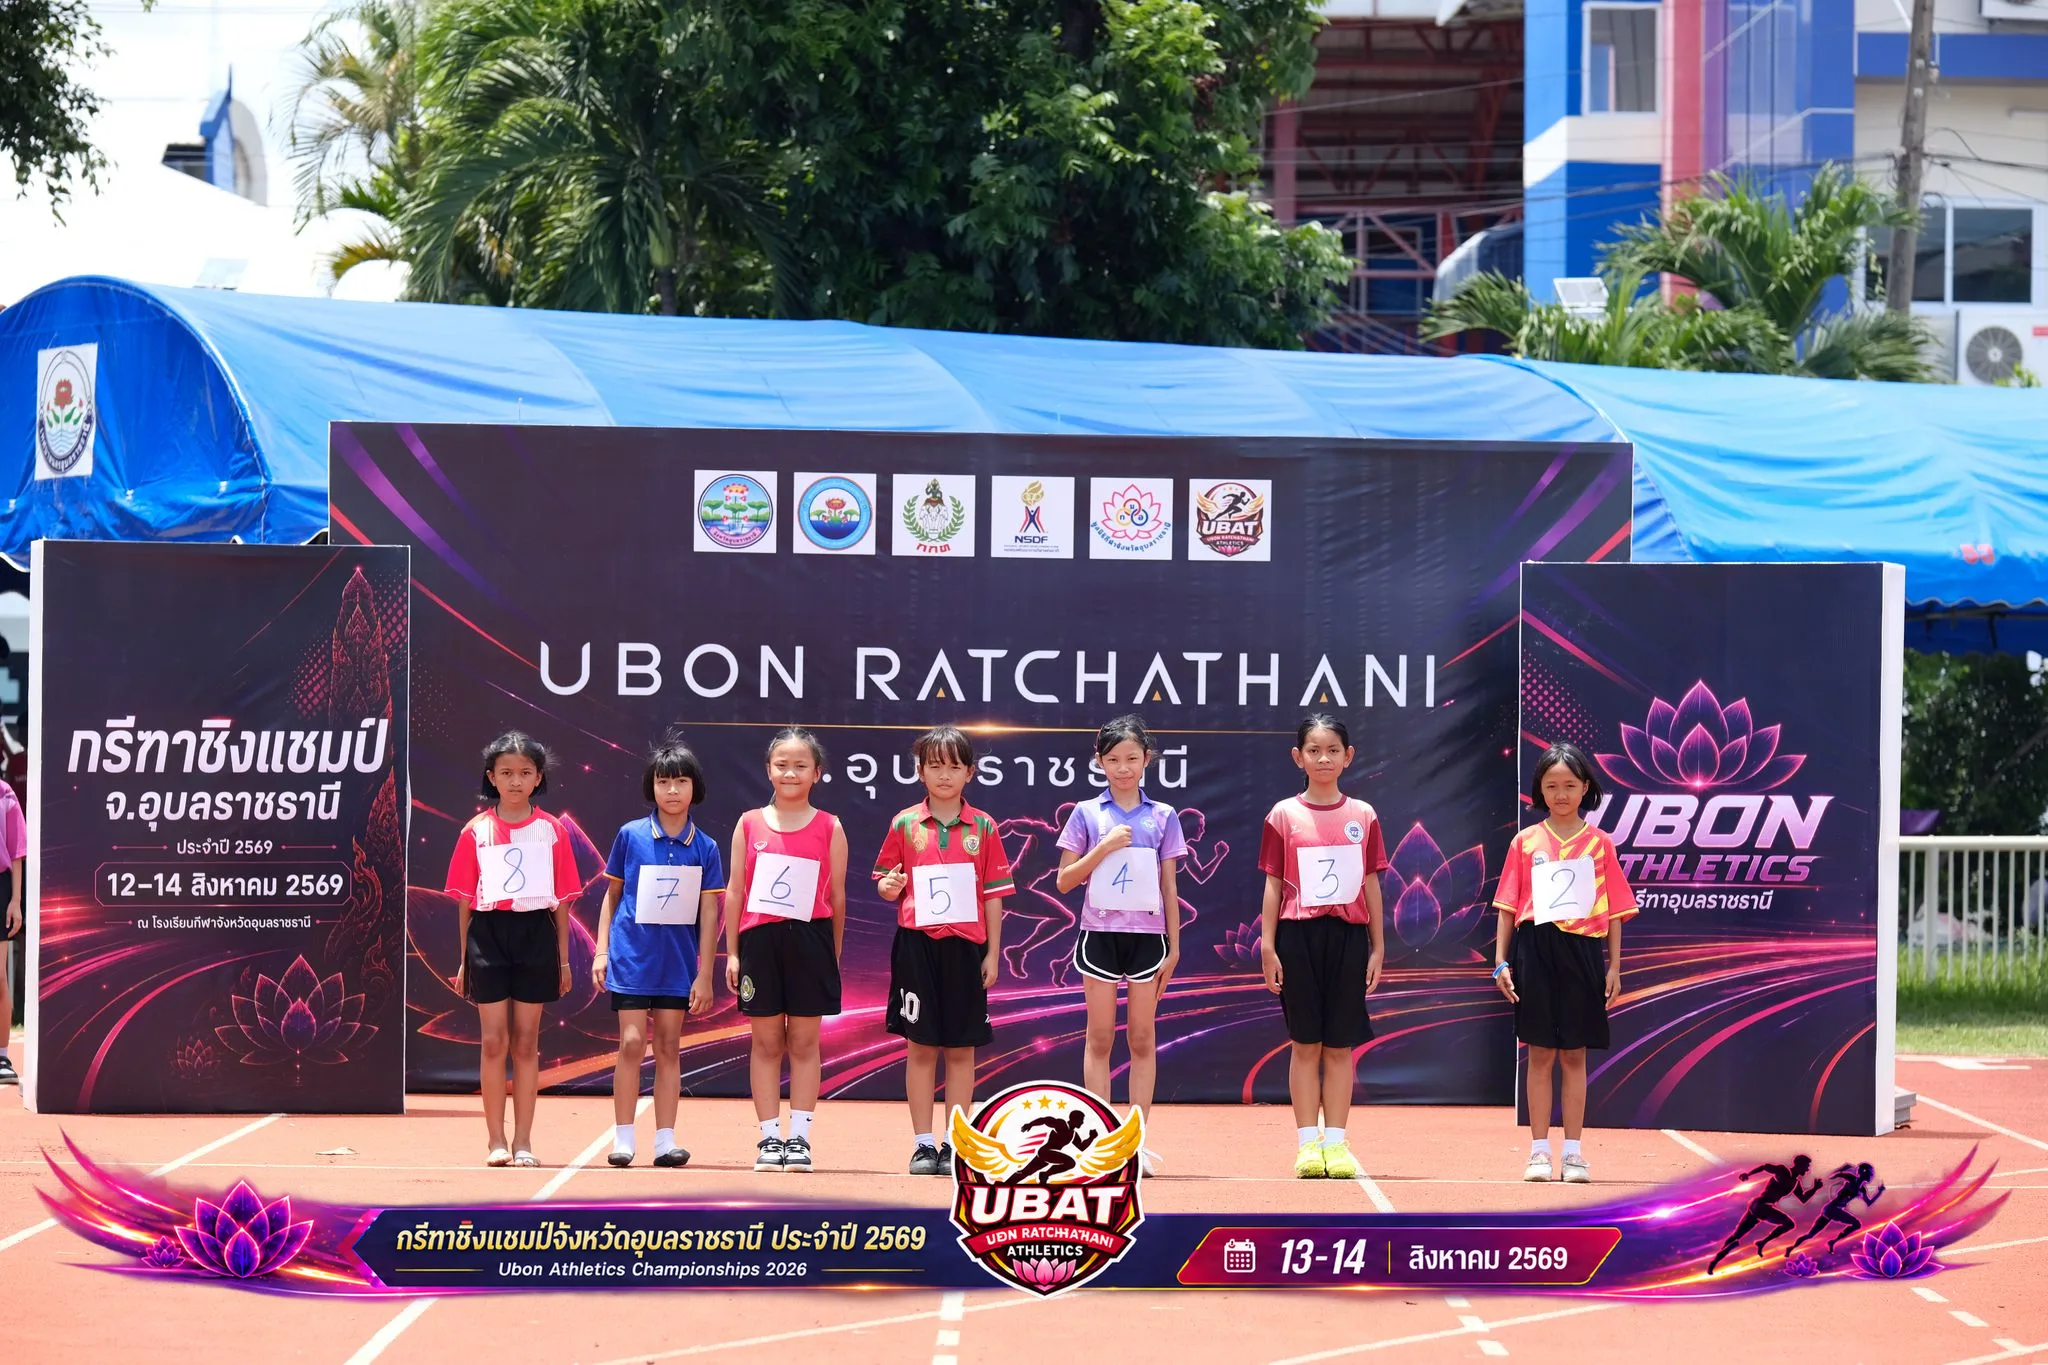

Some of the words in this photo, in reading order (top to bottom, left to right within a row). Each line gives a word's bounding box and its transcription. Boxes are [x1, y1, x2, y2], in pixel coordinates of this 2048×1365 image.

[1014, 535, 1049, 544] NSDF
[1201, 520, 1258, 536] UBAT
[916, 543, 952, 554] กกท
[540, 642, 804, 698] UBON
[857, 647, 1437, 707] RATCHATHANI
[67, 715, 389, 774] กรีฑาชิงแชมป์
[105, 781, 342, 832] จ.อุบลราชธานี
[1582, 793, 1836, 849] UBON
[176, 838, 230, 855] ประจำปี
[235, 839, 273, 854] 2569
[191, 871, 278, 897] สิงหาคม
[286, 874, 344, 896] 2569
[503, 847, 526, 893] 8
[769, 865, 792, 900] 6
[1111, 861, 1134, 894] 4
[1315, 858, 1340, 900] 3
[1618, 854, 1825, 882] THLETICS
[656, 877, 680, 911] 7
[928, 876, 952, 916] 5
[1549, 868, 1579, 909] 2
[1635, 889, 1774, 914] รีฑาอุบลราชธานี
[137, 917, 149, 930] ณ
[152, 914, 312, 932] โรงเรียนกีฬาจังหวัดอุบลราชธานี
[899, 987, 921, 1024] 10
